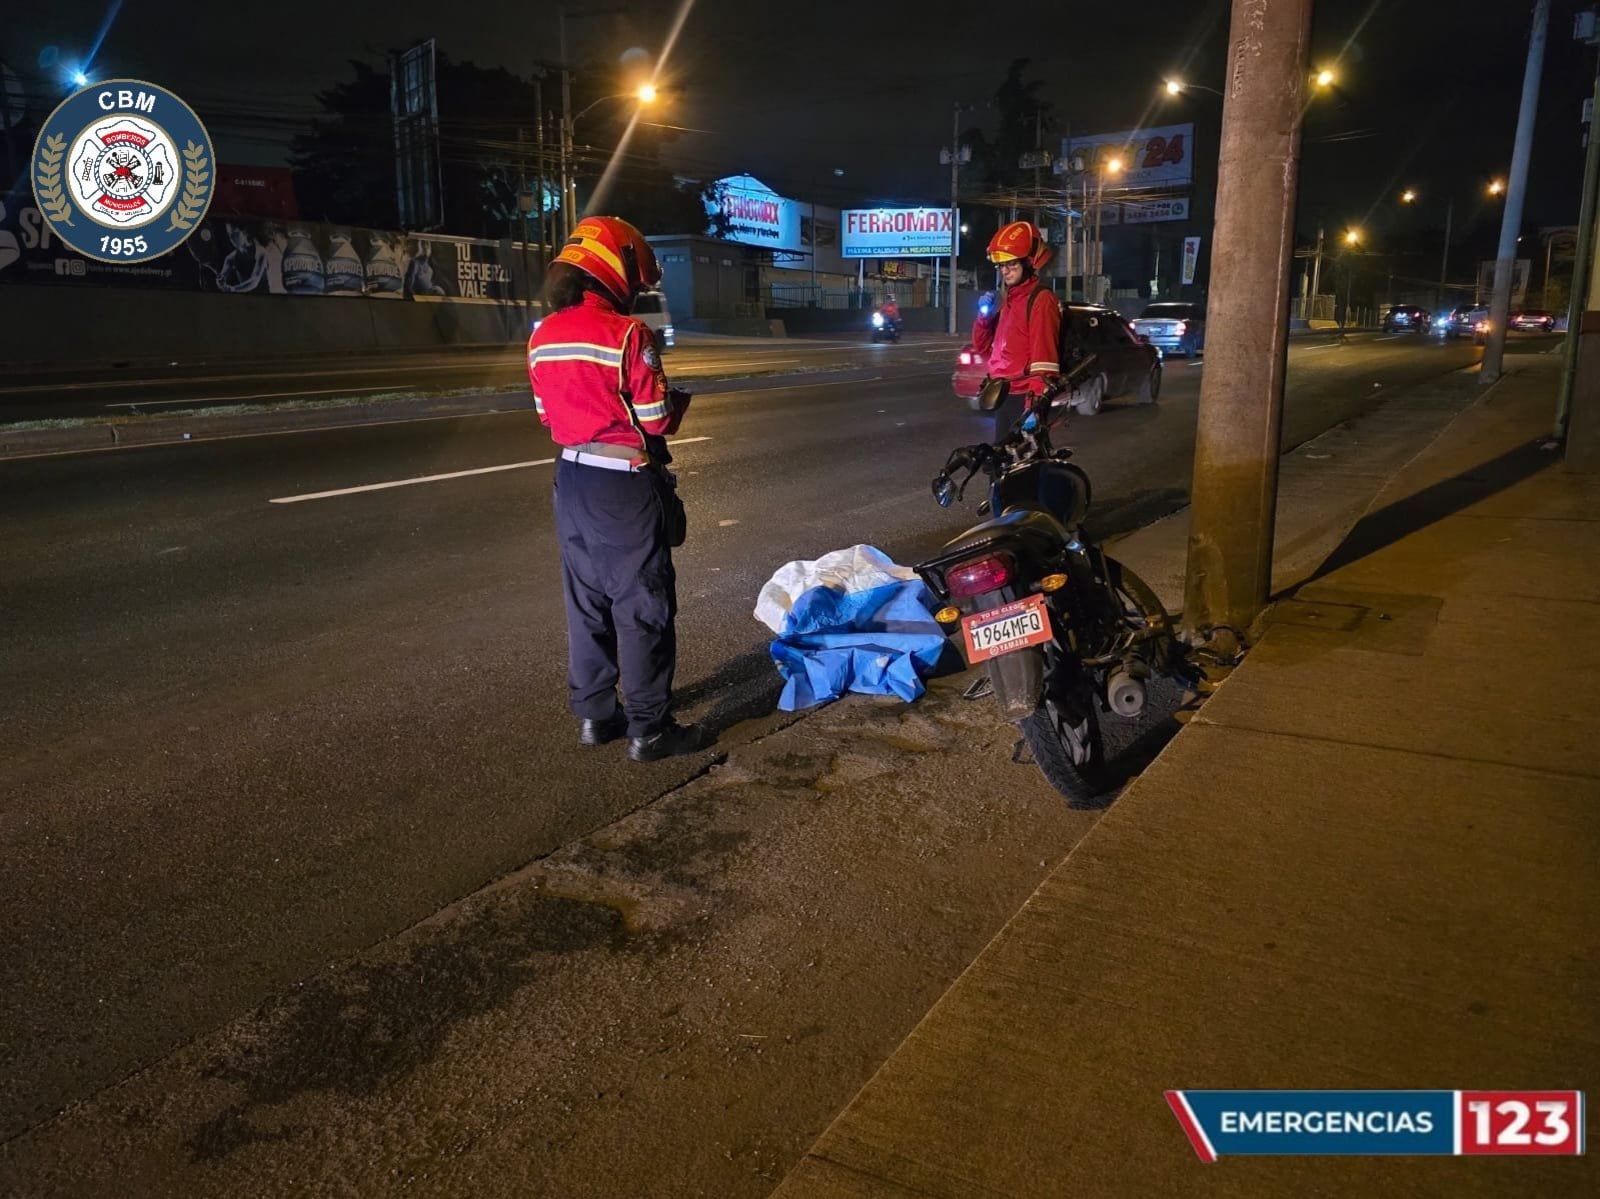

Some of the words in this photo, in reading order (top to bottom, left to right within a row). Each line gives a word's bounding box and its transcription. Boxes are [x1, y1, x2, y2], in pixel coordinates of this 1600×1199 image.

[1142, 134, 1184, 168] 24
[847, 211, 953, 234] FERROMAX
[455, 243, 471, 262] TU
[873, 247, 899, 255] CALIDAD
[910, 246, 931, 254] MEJOR
[458, 280, 487, 298] VALE
[999, 637, 1029, 652] YAMAHA
